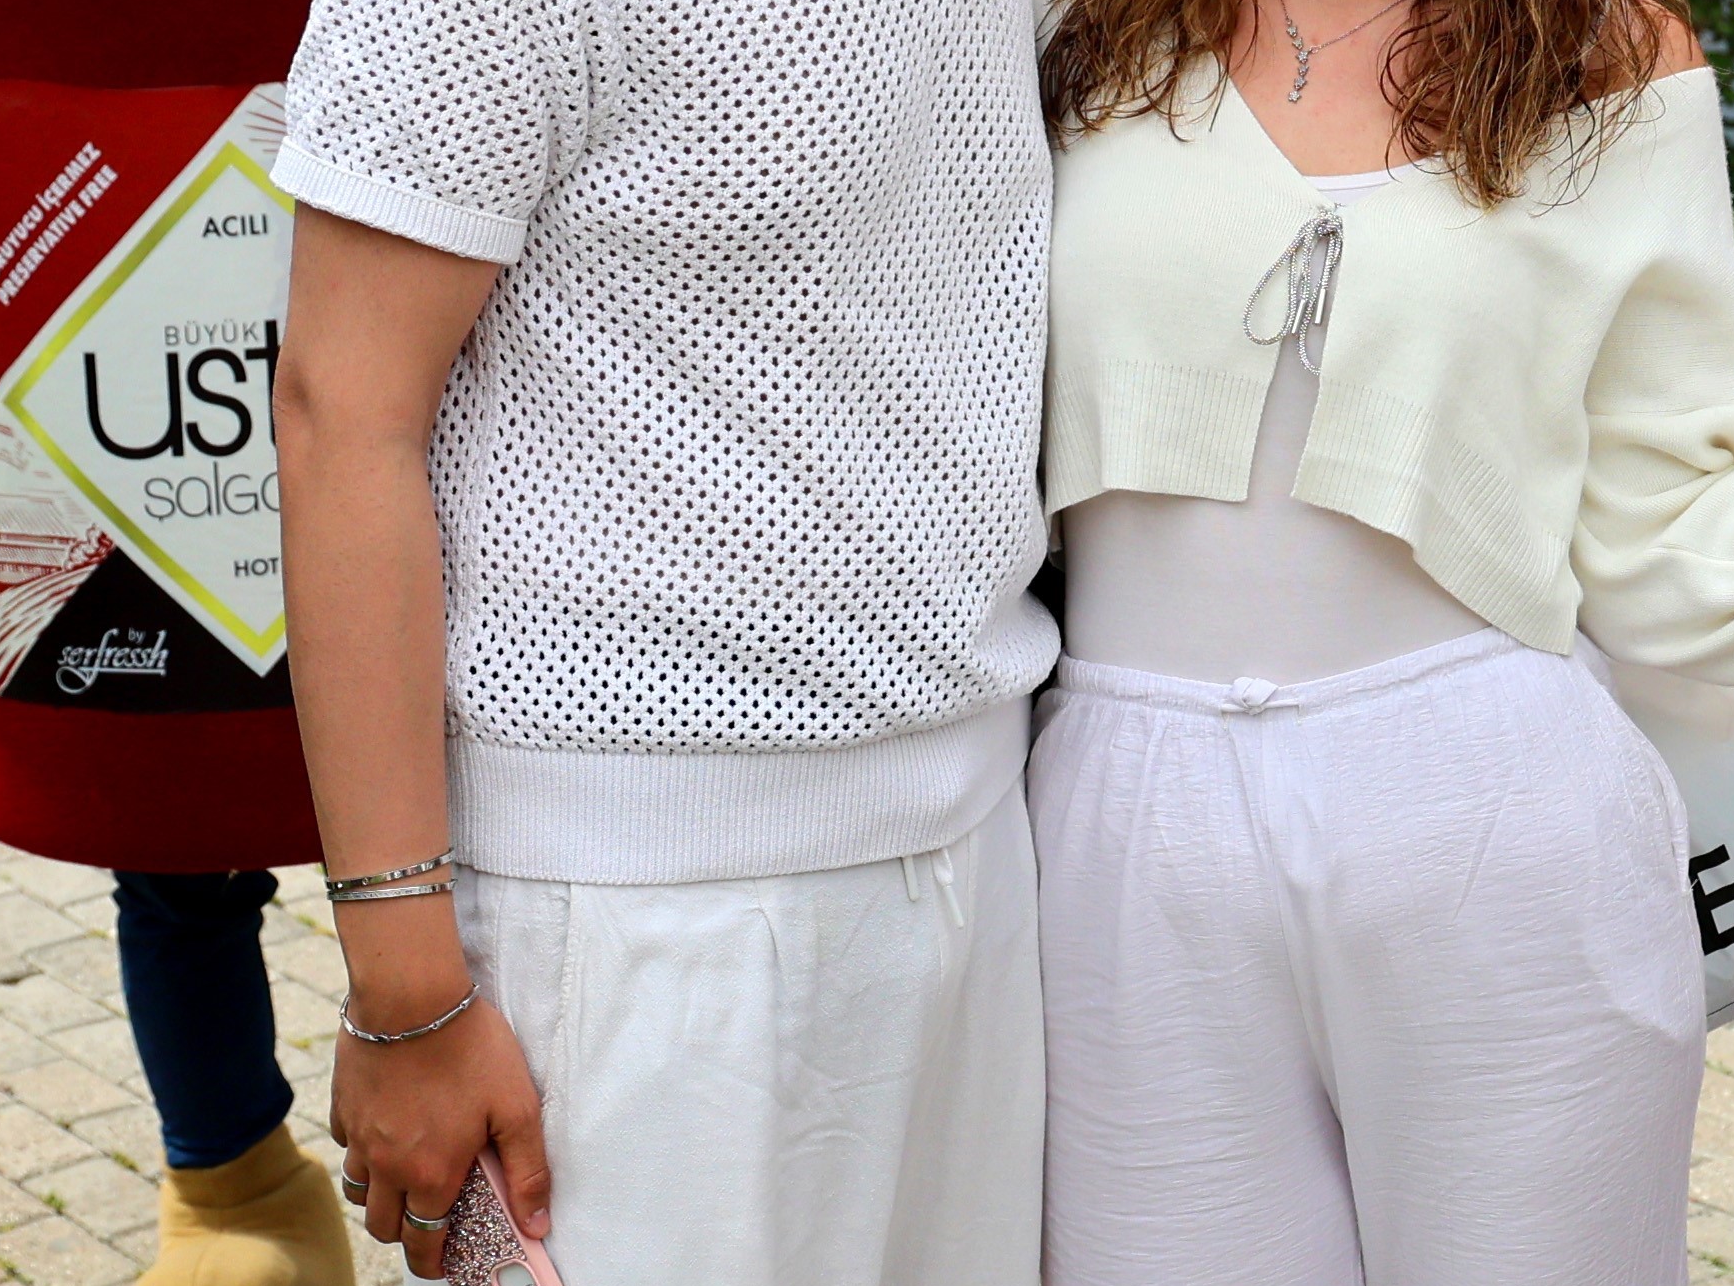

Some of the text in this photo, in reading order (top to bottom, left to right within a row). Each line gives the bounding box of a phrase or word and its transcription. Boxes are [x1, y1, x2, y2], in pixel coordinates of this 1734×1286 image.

[35, 140, 102, 212] İÇERMEZ
[78, 164, 119, 208] FREE
[202, 214, 268, 238] ACILI
[164, 320, 260, 347] BÜYÜK
[83, 319, 282, 461] ust
[234, 557, 279, 578] HOT
[128, 627, 146, 644] by
